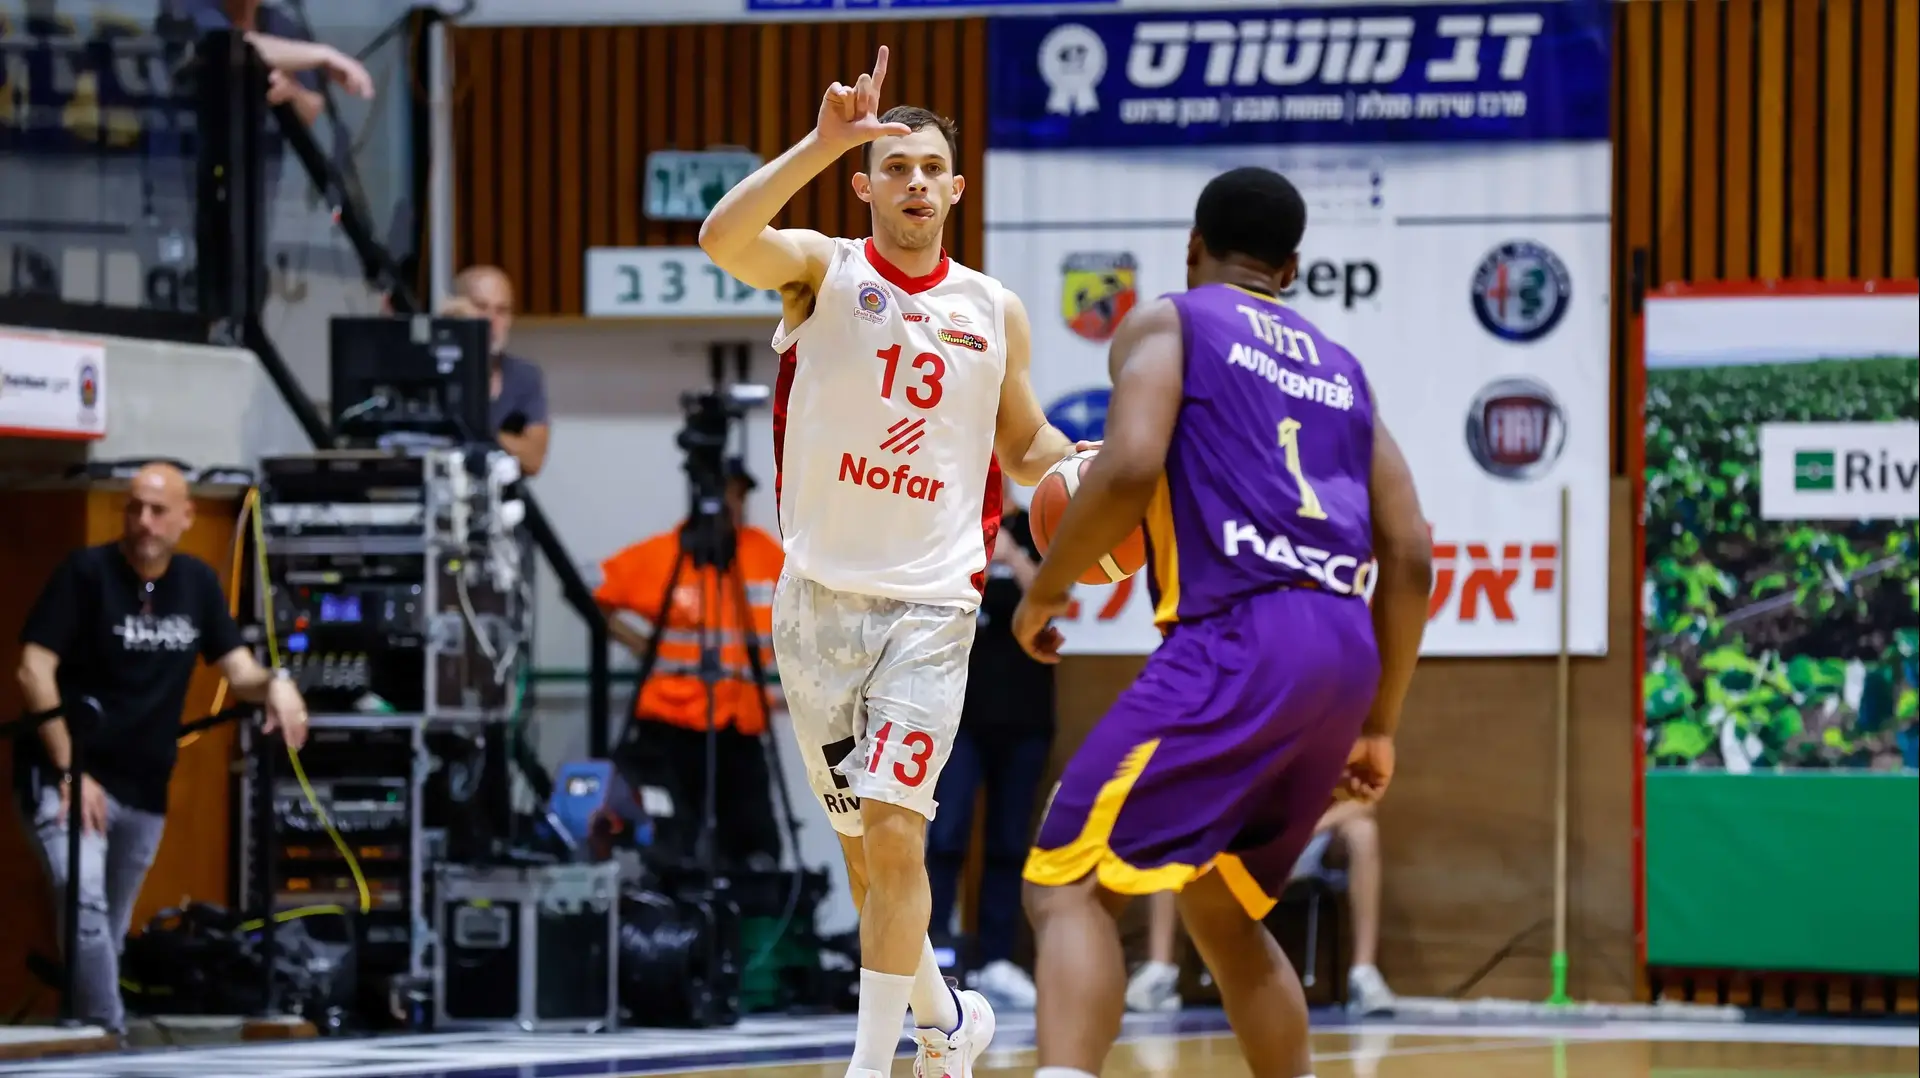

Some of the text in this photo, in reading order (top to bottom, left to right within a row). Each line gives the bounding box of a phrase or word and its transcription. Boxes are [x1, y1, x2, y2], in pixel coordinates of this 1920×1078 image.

[1126, 14, 1544, 88] דב מוטורס
[616, 264, 643, 303] ב
[659, 261, 685, 303] 3
[876, 344, 946, 409] 13
[838, 453, 945, 502] Nofar
[1278, 417, 1328, 520] 1
[1845, 449, 1919, 491] Riv
[868, 721, 934, 788] 13
